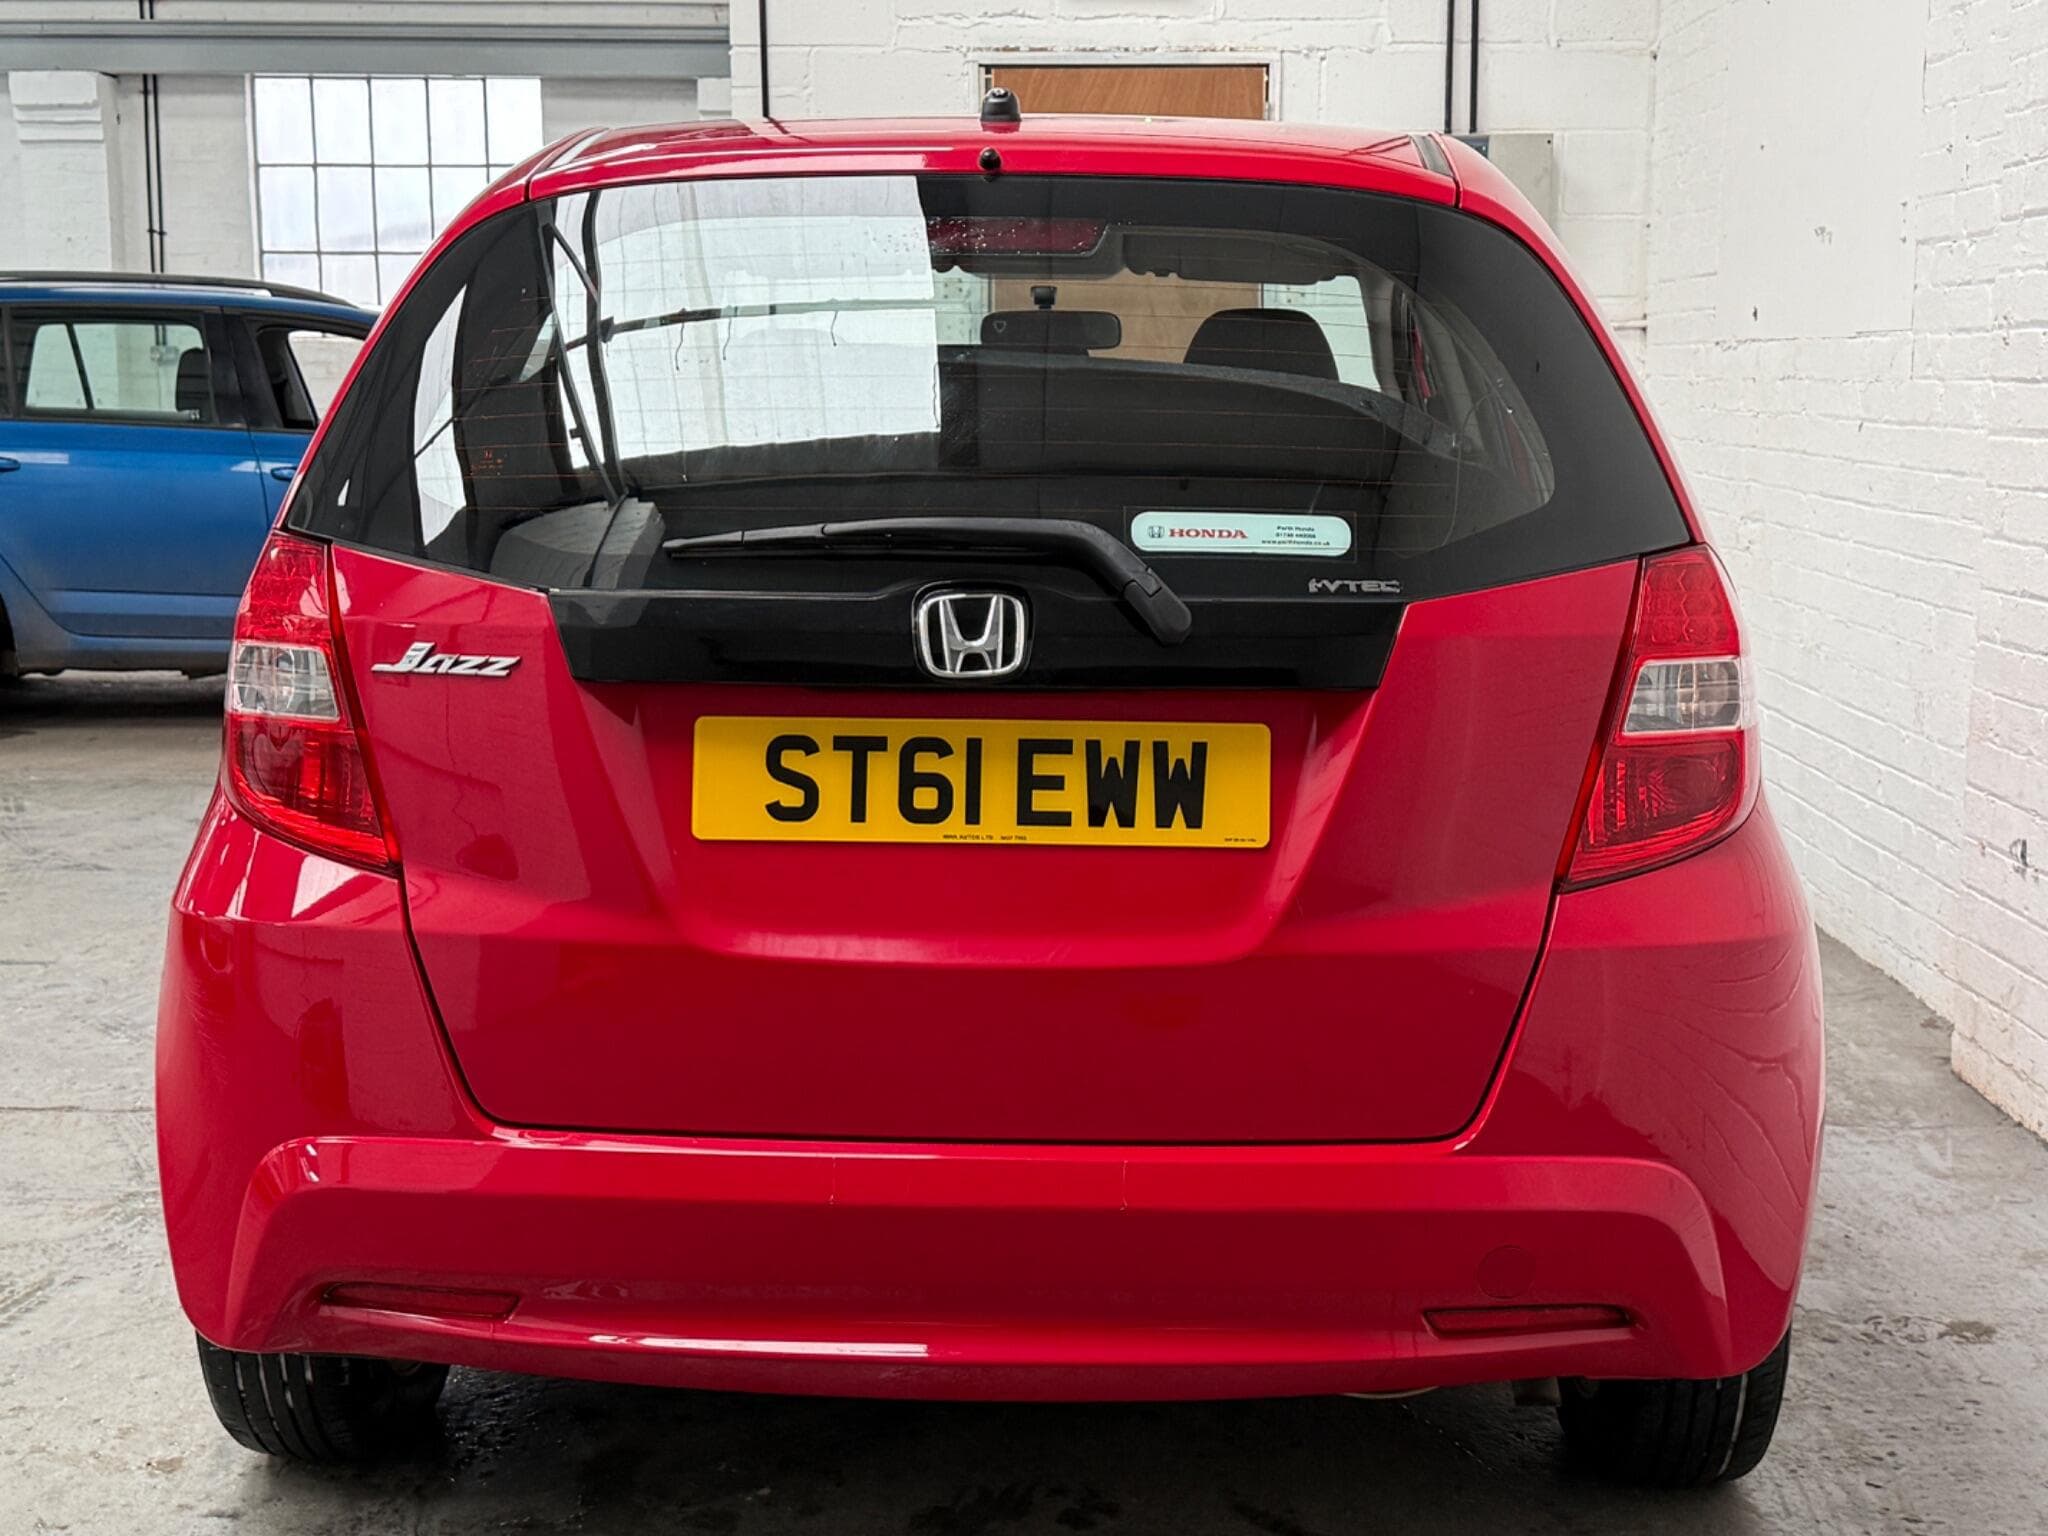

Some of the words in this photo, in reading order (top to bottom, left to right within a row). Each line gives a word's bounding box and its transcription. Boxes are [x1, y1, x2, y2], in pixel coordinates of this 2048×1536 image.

[1168, 528, 1248, 539] HONDA
[371, 641, 521, 677] Jazz
[765, 733, 983, 826] ST61
[1016, 737, 1209, 830] EWW
